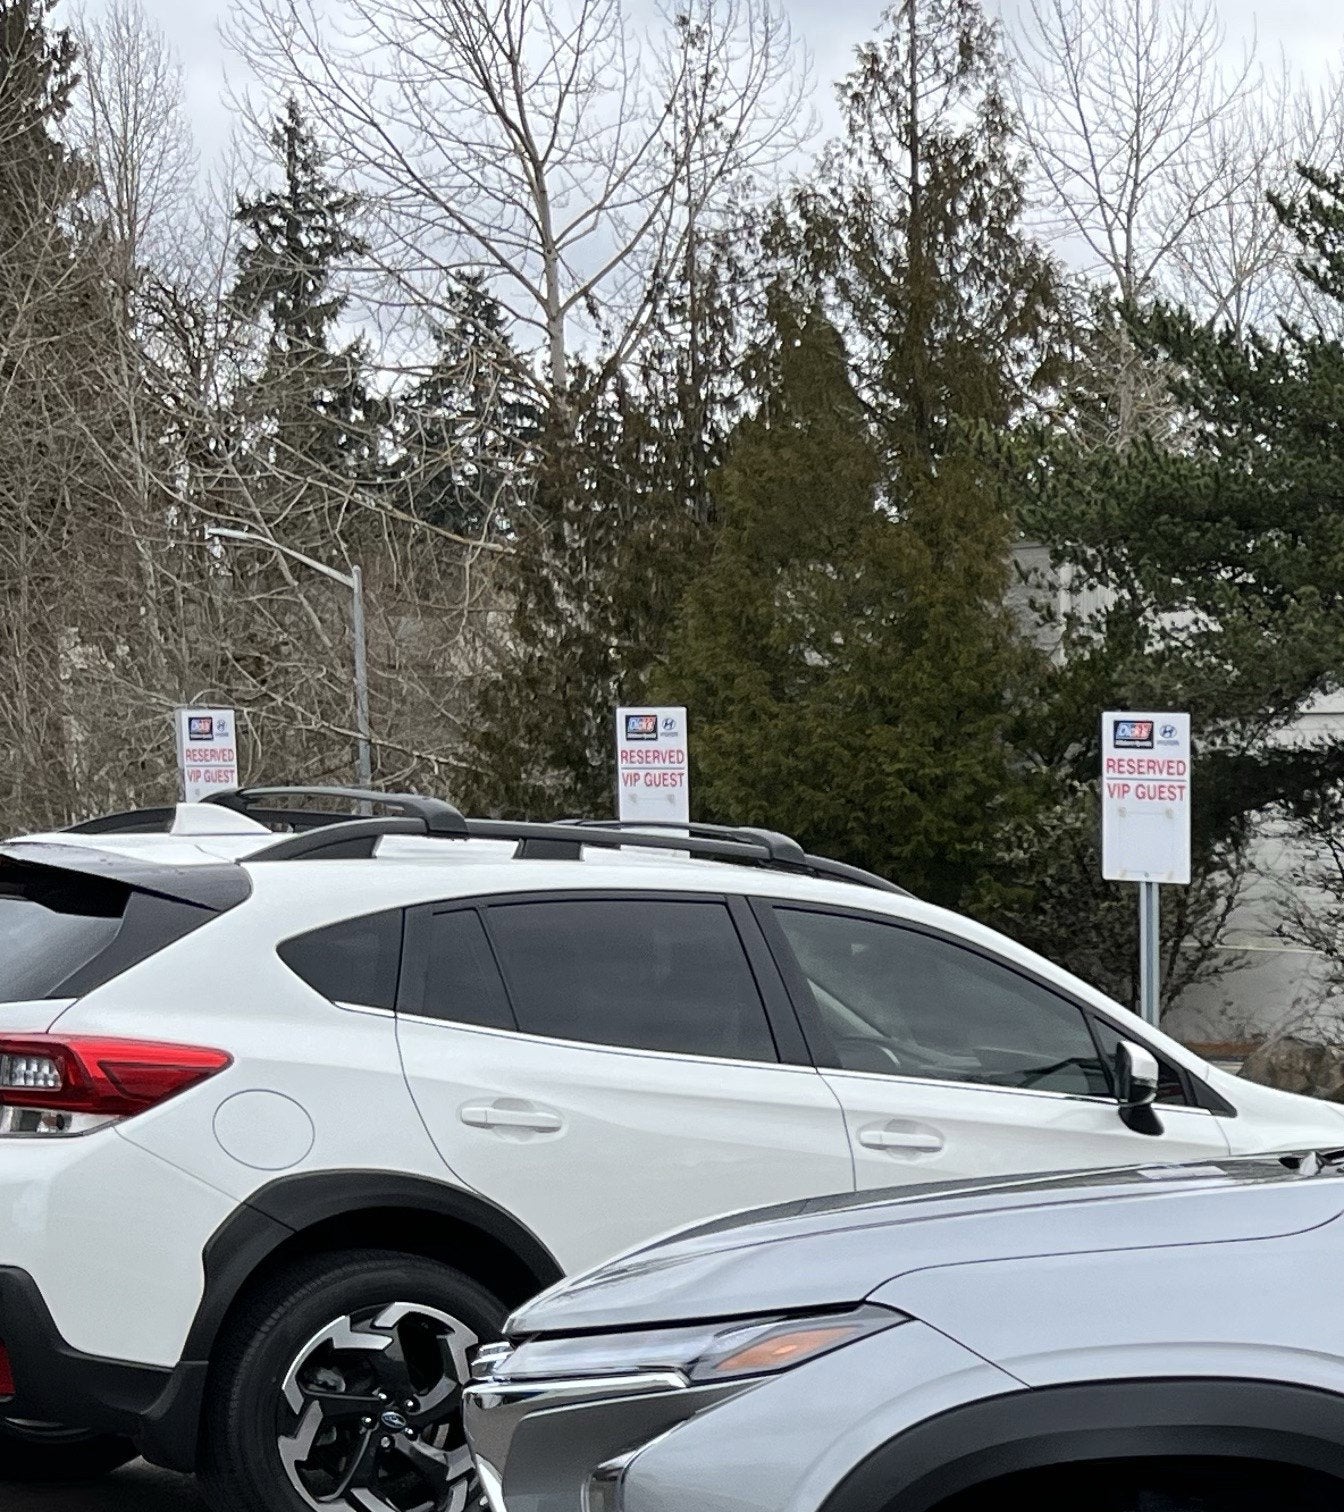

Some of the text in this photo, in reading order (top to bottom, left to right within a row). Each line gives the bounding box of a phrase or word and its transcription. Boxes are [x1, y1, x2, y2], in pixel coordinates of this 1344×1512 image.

[185, 748, 234, 762] RESERVED
[620, 750, 684, 764] RESERVED
[1106, 758, 1186, 776] RESERVED
[187, 769, 235, 783] VIP GUEST
[622, 772, 684, 788] VIP GUEST
[1107, 783, 1186, 801] VIP GUEST
